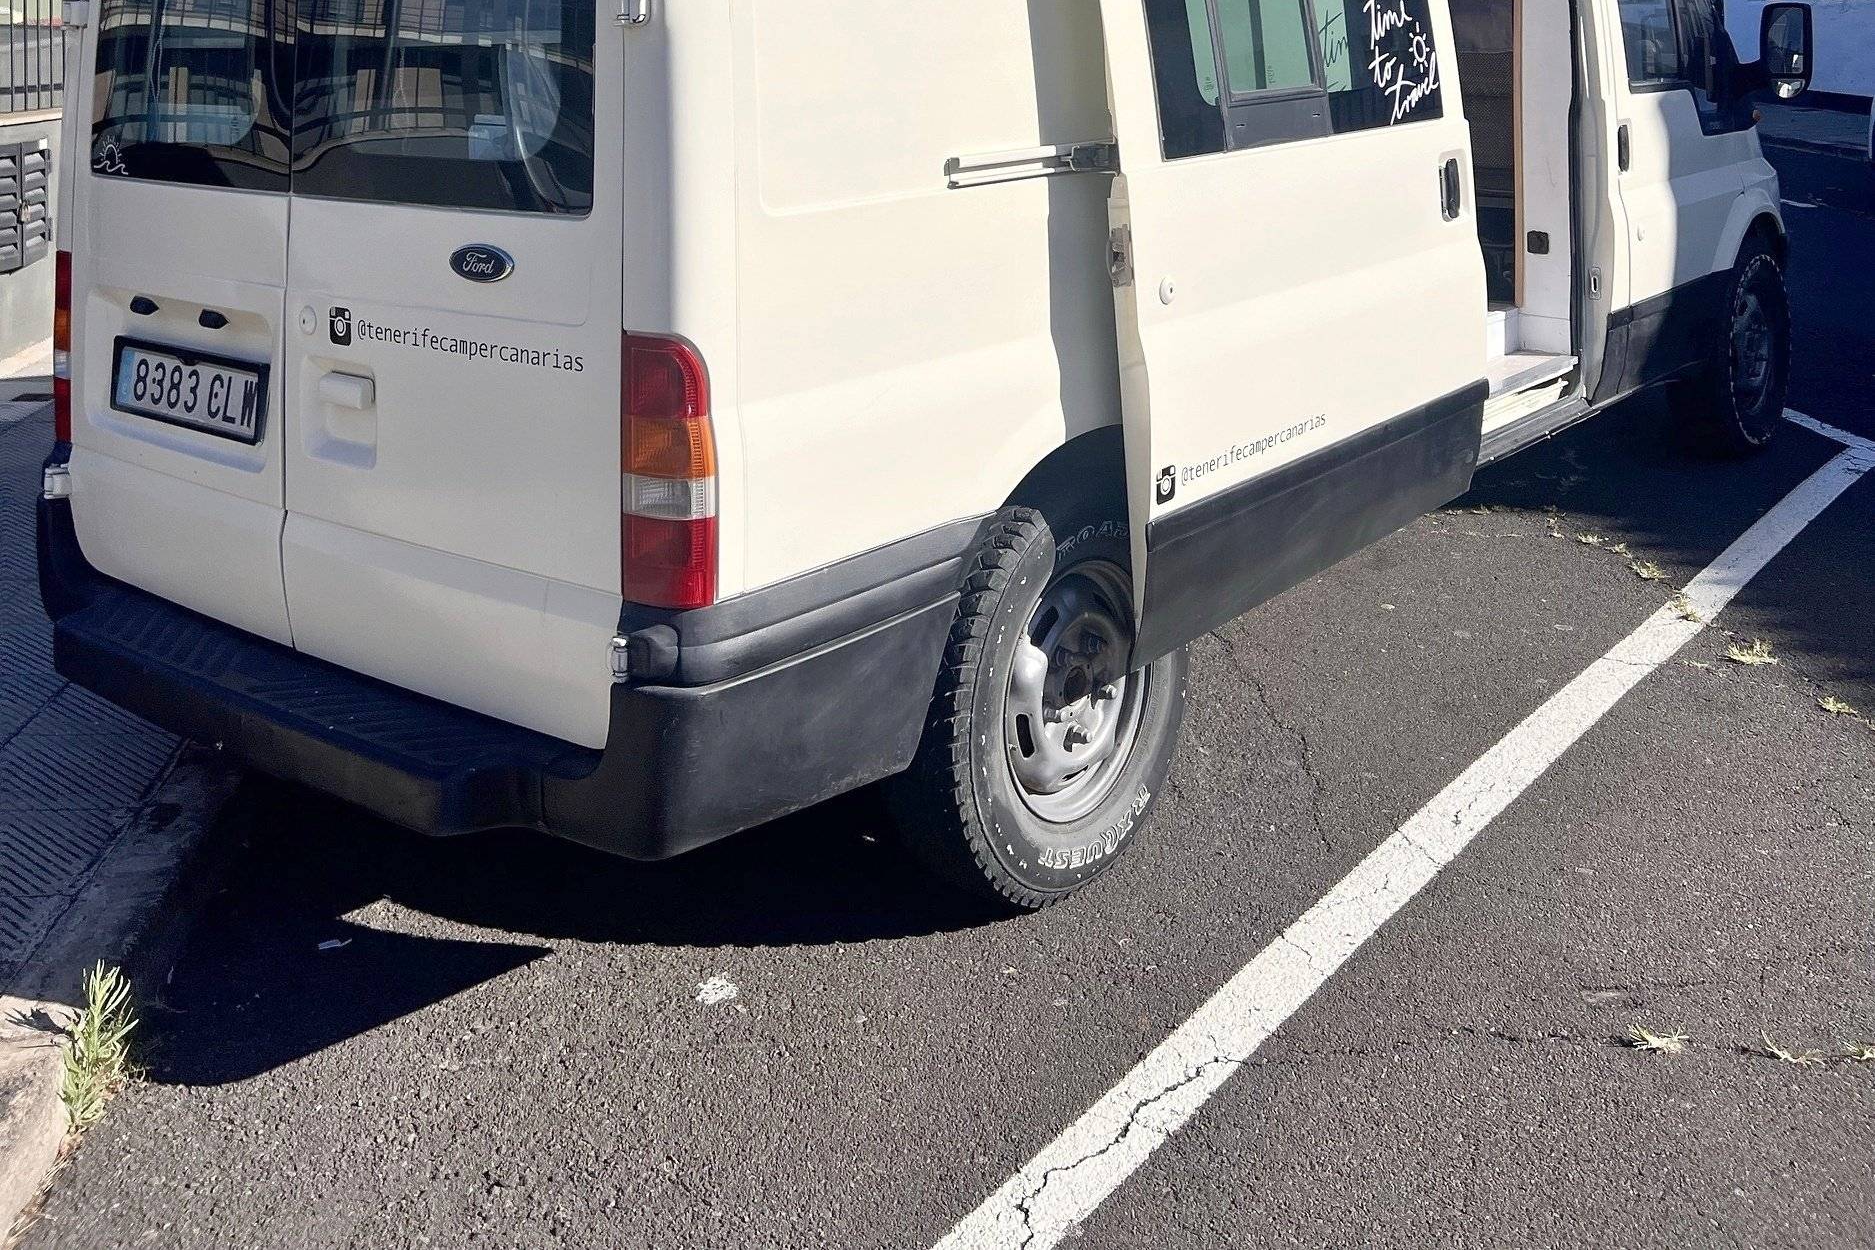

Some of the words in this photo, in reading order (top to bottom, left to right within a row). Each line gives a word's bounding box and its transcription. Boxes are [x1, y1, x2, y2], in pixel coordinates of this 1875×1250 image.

[1368, 45, 1397, 87] to
[1385, 51, 1439, 125] travel
[462, 251, 495, 275] Ford
[357, 319, 585, 373] @tenerifecampercanarias
[133, 358, 200, 413] 8383
[207, 373, 258, 428] CLW
[1181, 413, 1327, 487] @tenerifecampercanarias
[1037, 783, 1151, 870] RXQUEST
